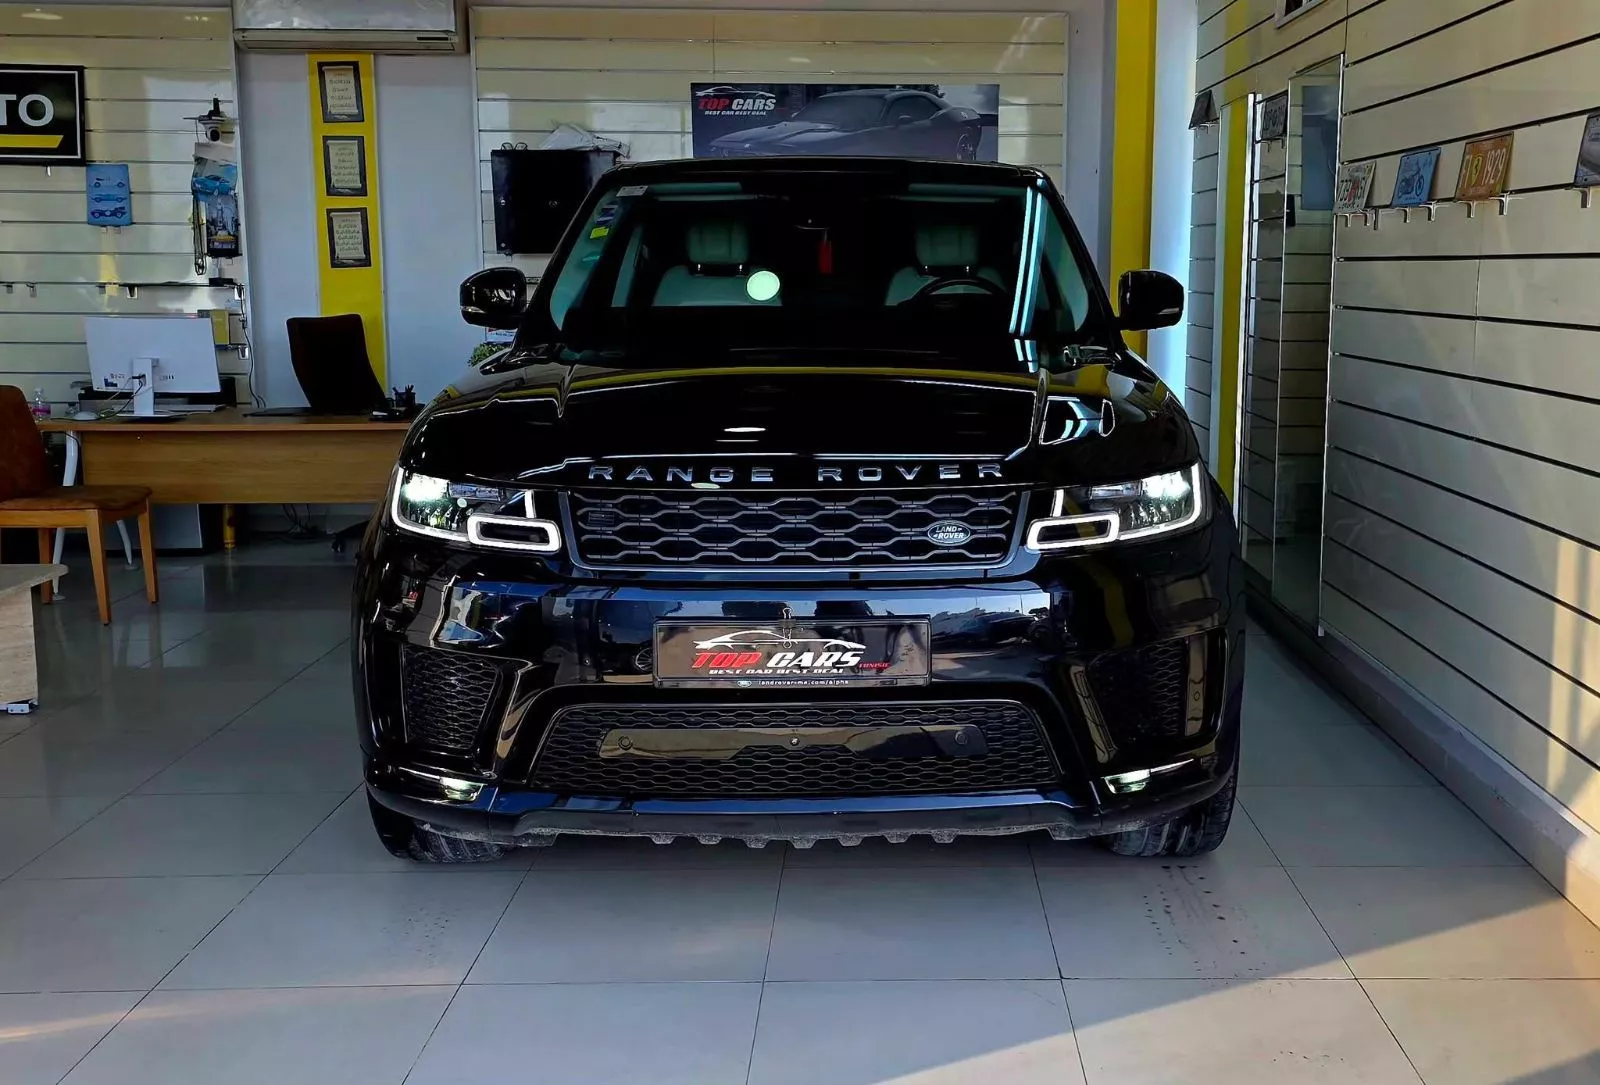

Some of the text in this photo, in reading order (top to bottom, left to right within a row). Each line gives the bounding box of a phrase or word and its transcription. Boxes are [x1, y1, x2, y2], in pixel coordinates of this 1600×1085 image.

[0, 94, 54, 127] TO
[699, 98, 776, 110] TOP CARS
[1481, 148, 1507, 186] 1929
[588, 463, 1002, 482] RANGE ROVER
[935, 525, 957, 533] LAND
[937, 532, 965, 540] ROVER
[692, 651, 864, 669] TOP CARS
